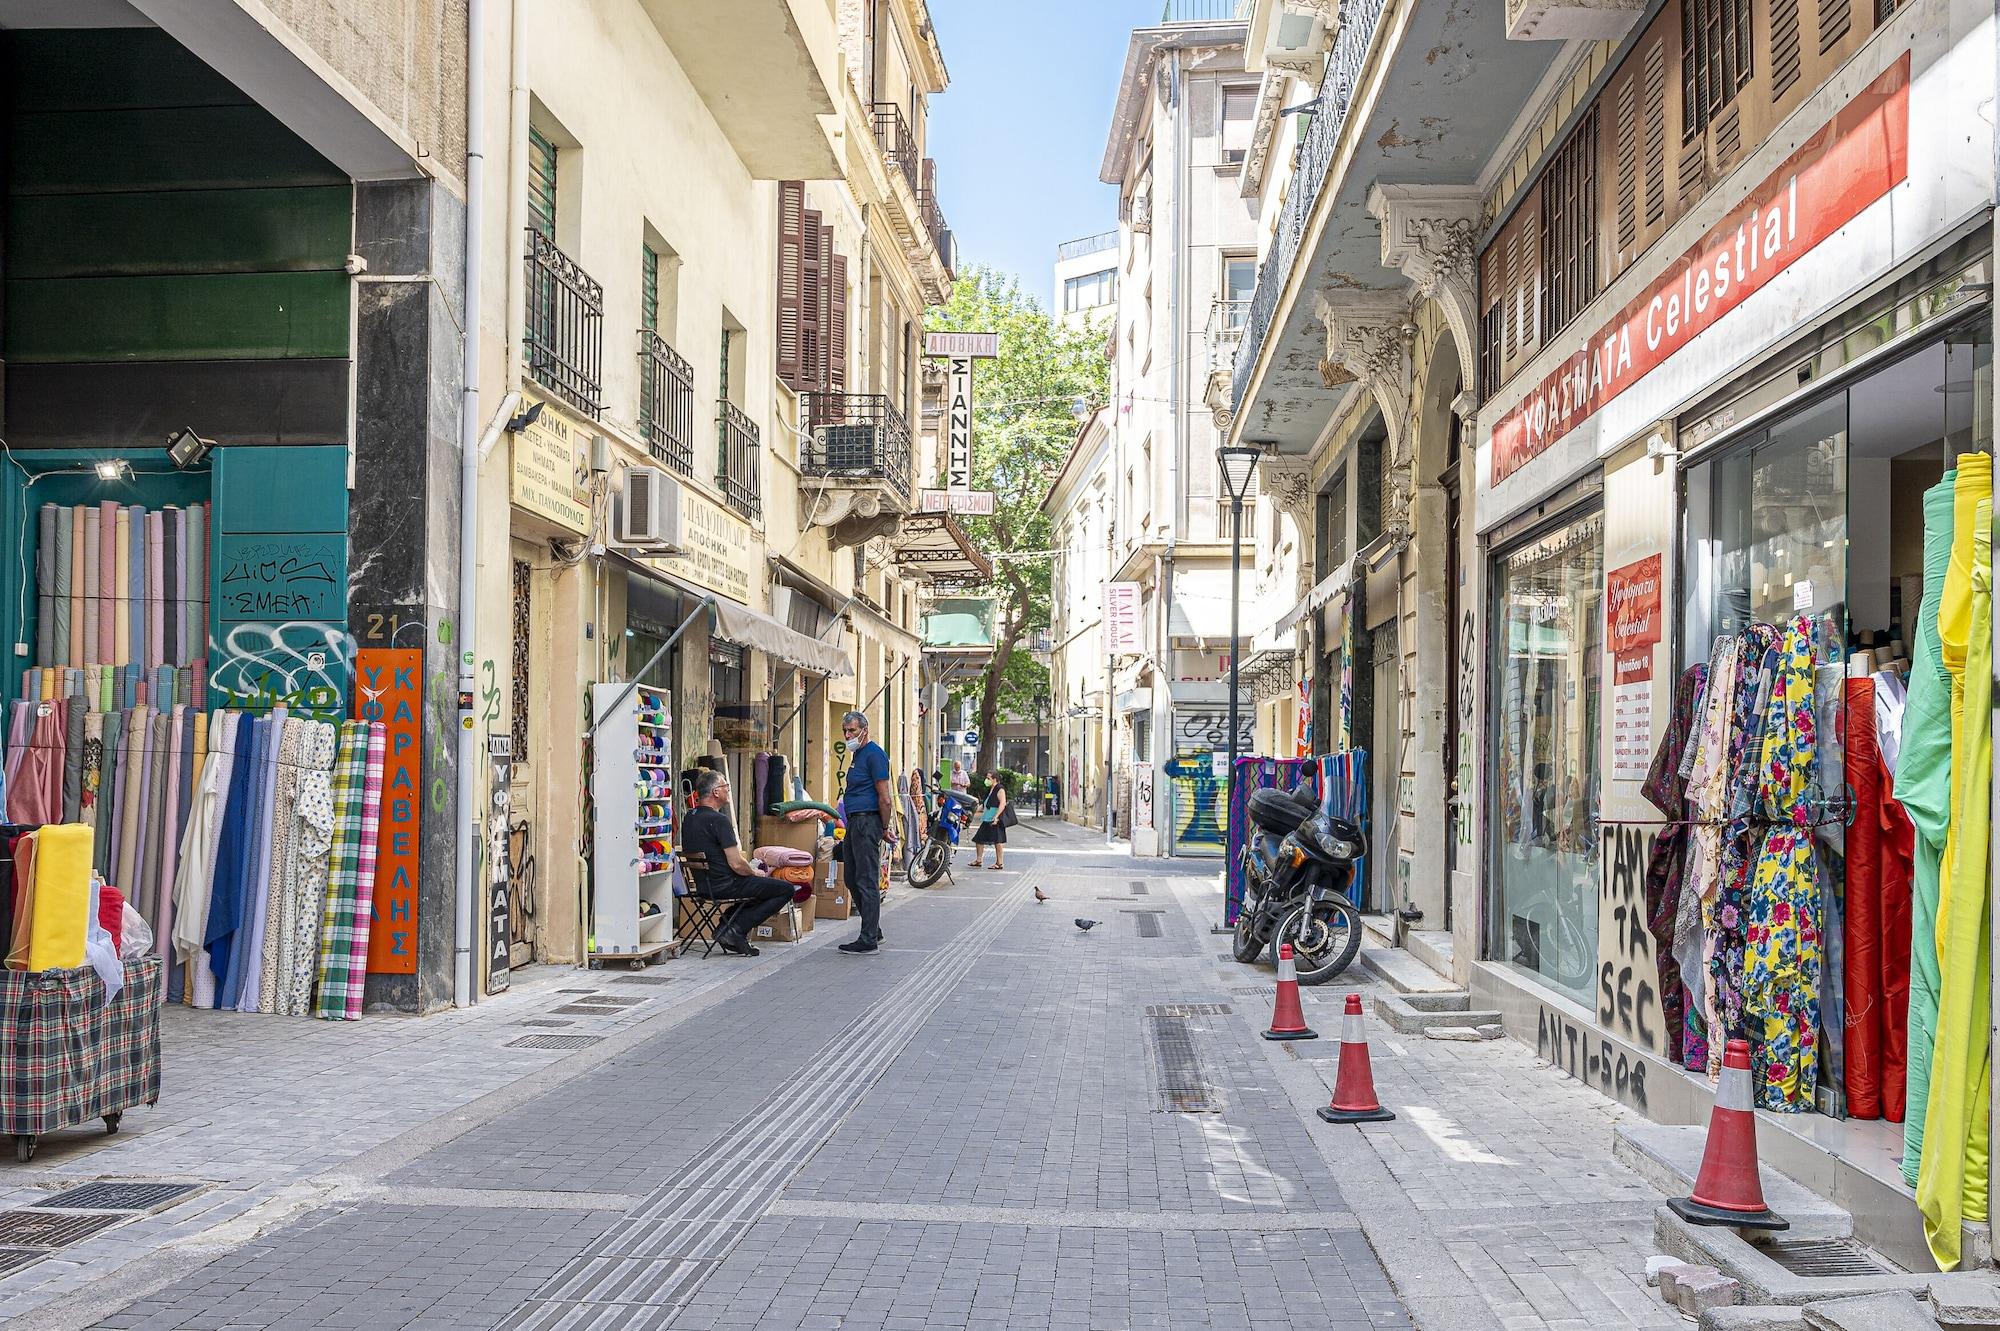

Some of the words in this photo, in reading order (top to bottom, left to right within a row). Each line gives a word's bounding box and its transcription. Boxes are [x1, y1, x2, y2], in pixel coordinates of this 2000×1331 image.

[1646, 175, 1797, 351] Celestial
[929, 335, 992, 352] ΑΠΟΘΗΚΗ
[518, 397, 568, 440] ΑΠΘΗΚΗ
[950, 359, 968, 486] ΣΙΑΝΝΗΣ
[538, 493, 585, 526] ΠΑΥΛΟΠΟΥΛΟΣ
[1109, 588, 1117, 618] SILVER
[367, 614, 399, 639] 21
[1110, 620, 1118, 649] HOUSE
[1614, 608, 1651, 639] Celestial
[1641, 655, 1649, 668] 18
[1138, 781, 1151, 803] 13
[390, 667, 414, 956] ΚΑΡΑΒΕΛΗΣ
[493, 765, 509, 959] ΥΦΑΣΜΑΤΑ
